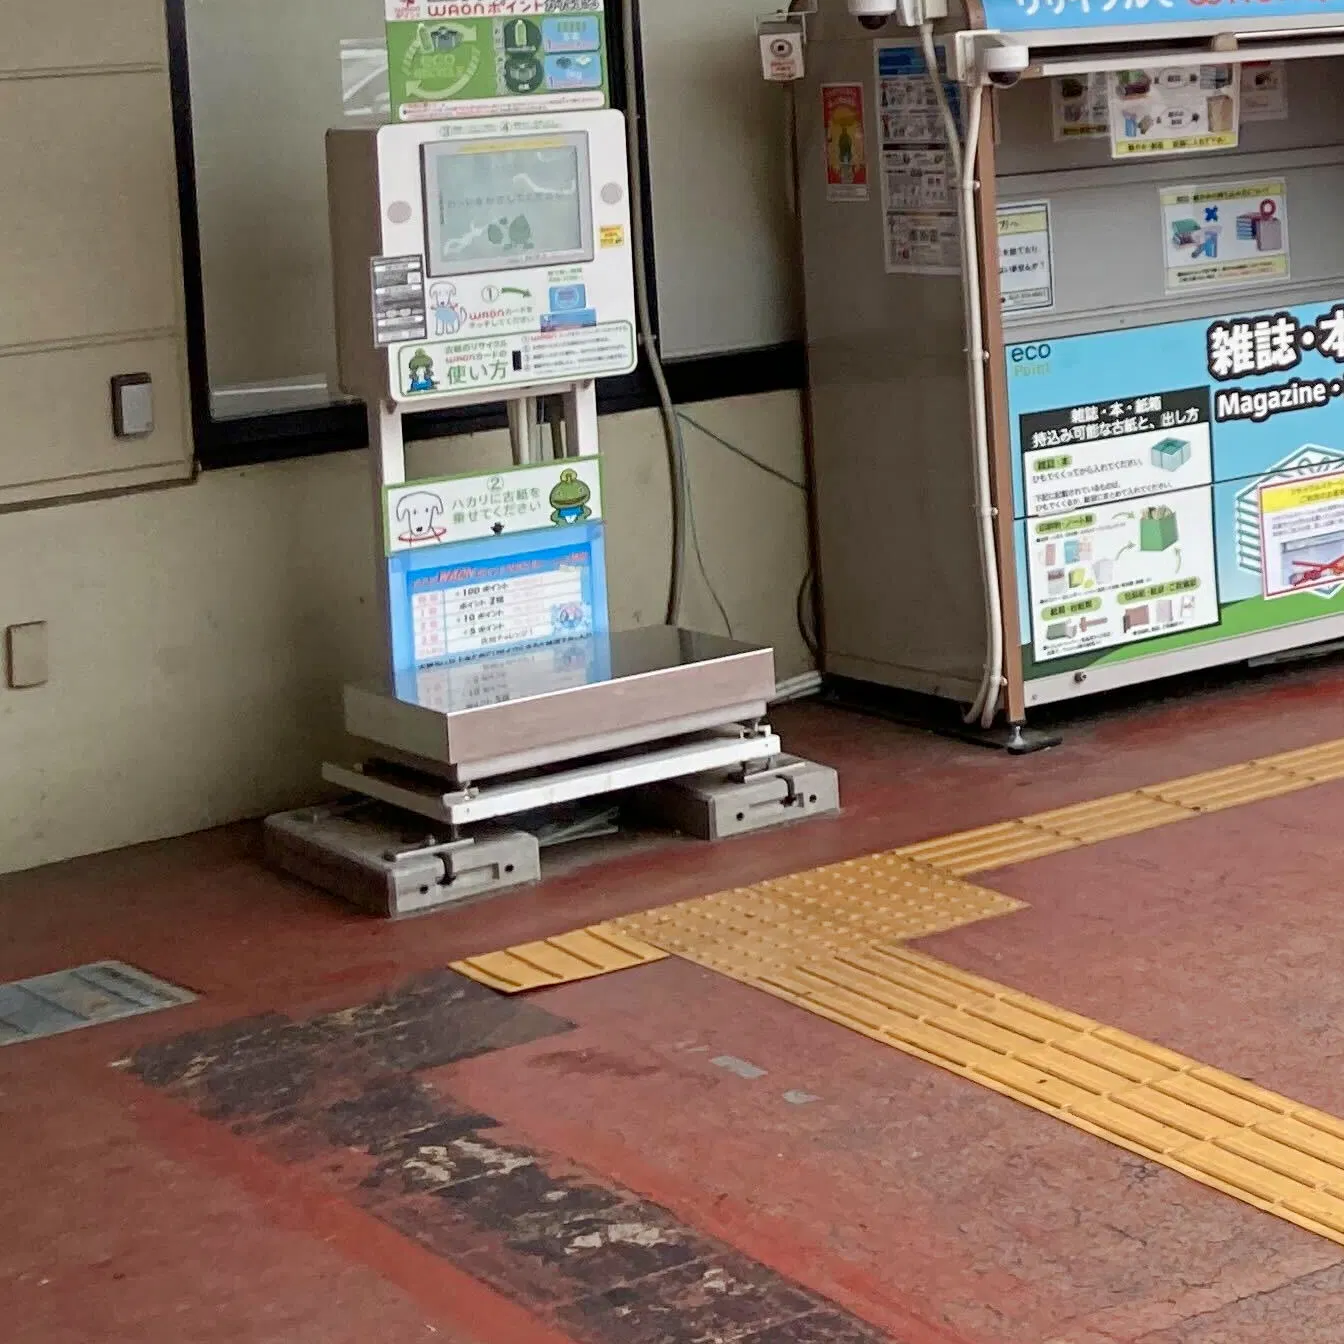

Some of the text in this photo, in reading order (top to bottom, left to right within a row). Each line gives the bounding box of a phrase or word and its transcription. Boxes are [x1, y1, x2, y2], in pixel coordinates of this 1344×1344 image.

[1011, 343, 1052, 362] eco
[447, 360, 507, 385] 使い方
